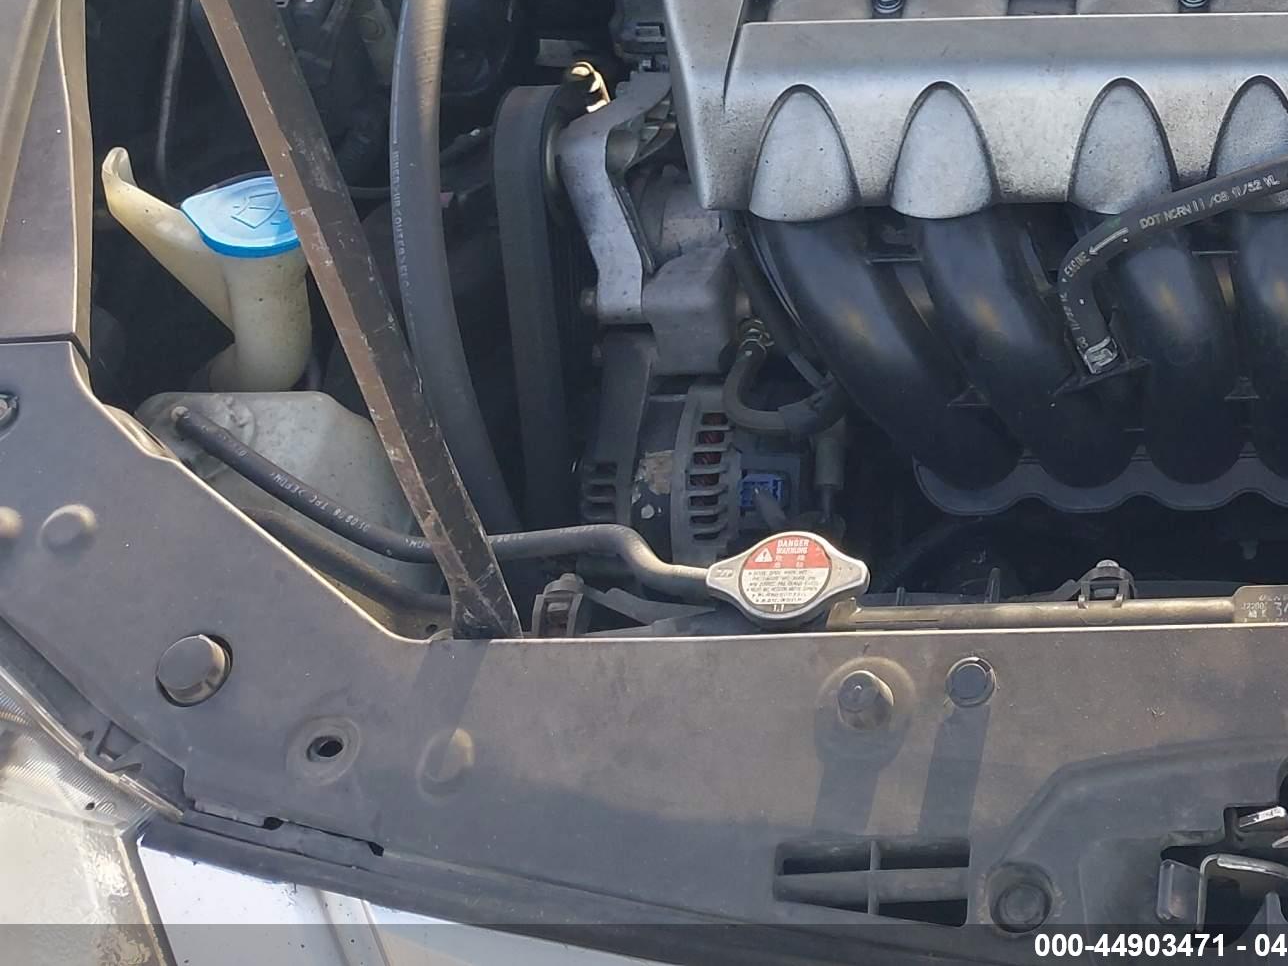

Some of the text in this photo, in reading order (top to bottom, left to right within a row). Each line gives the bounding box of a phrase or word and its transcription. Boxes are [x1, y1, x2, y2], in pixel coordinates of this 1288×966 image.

[1139, 212, 1162, 229] DOT
[777, 538, 809, 548] DANGER
[776, 547, 808, 555] WARNING
